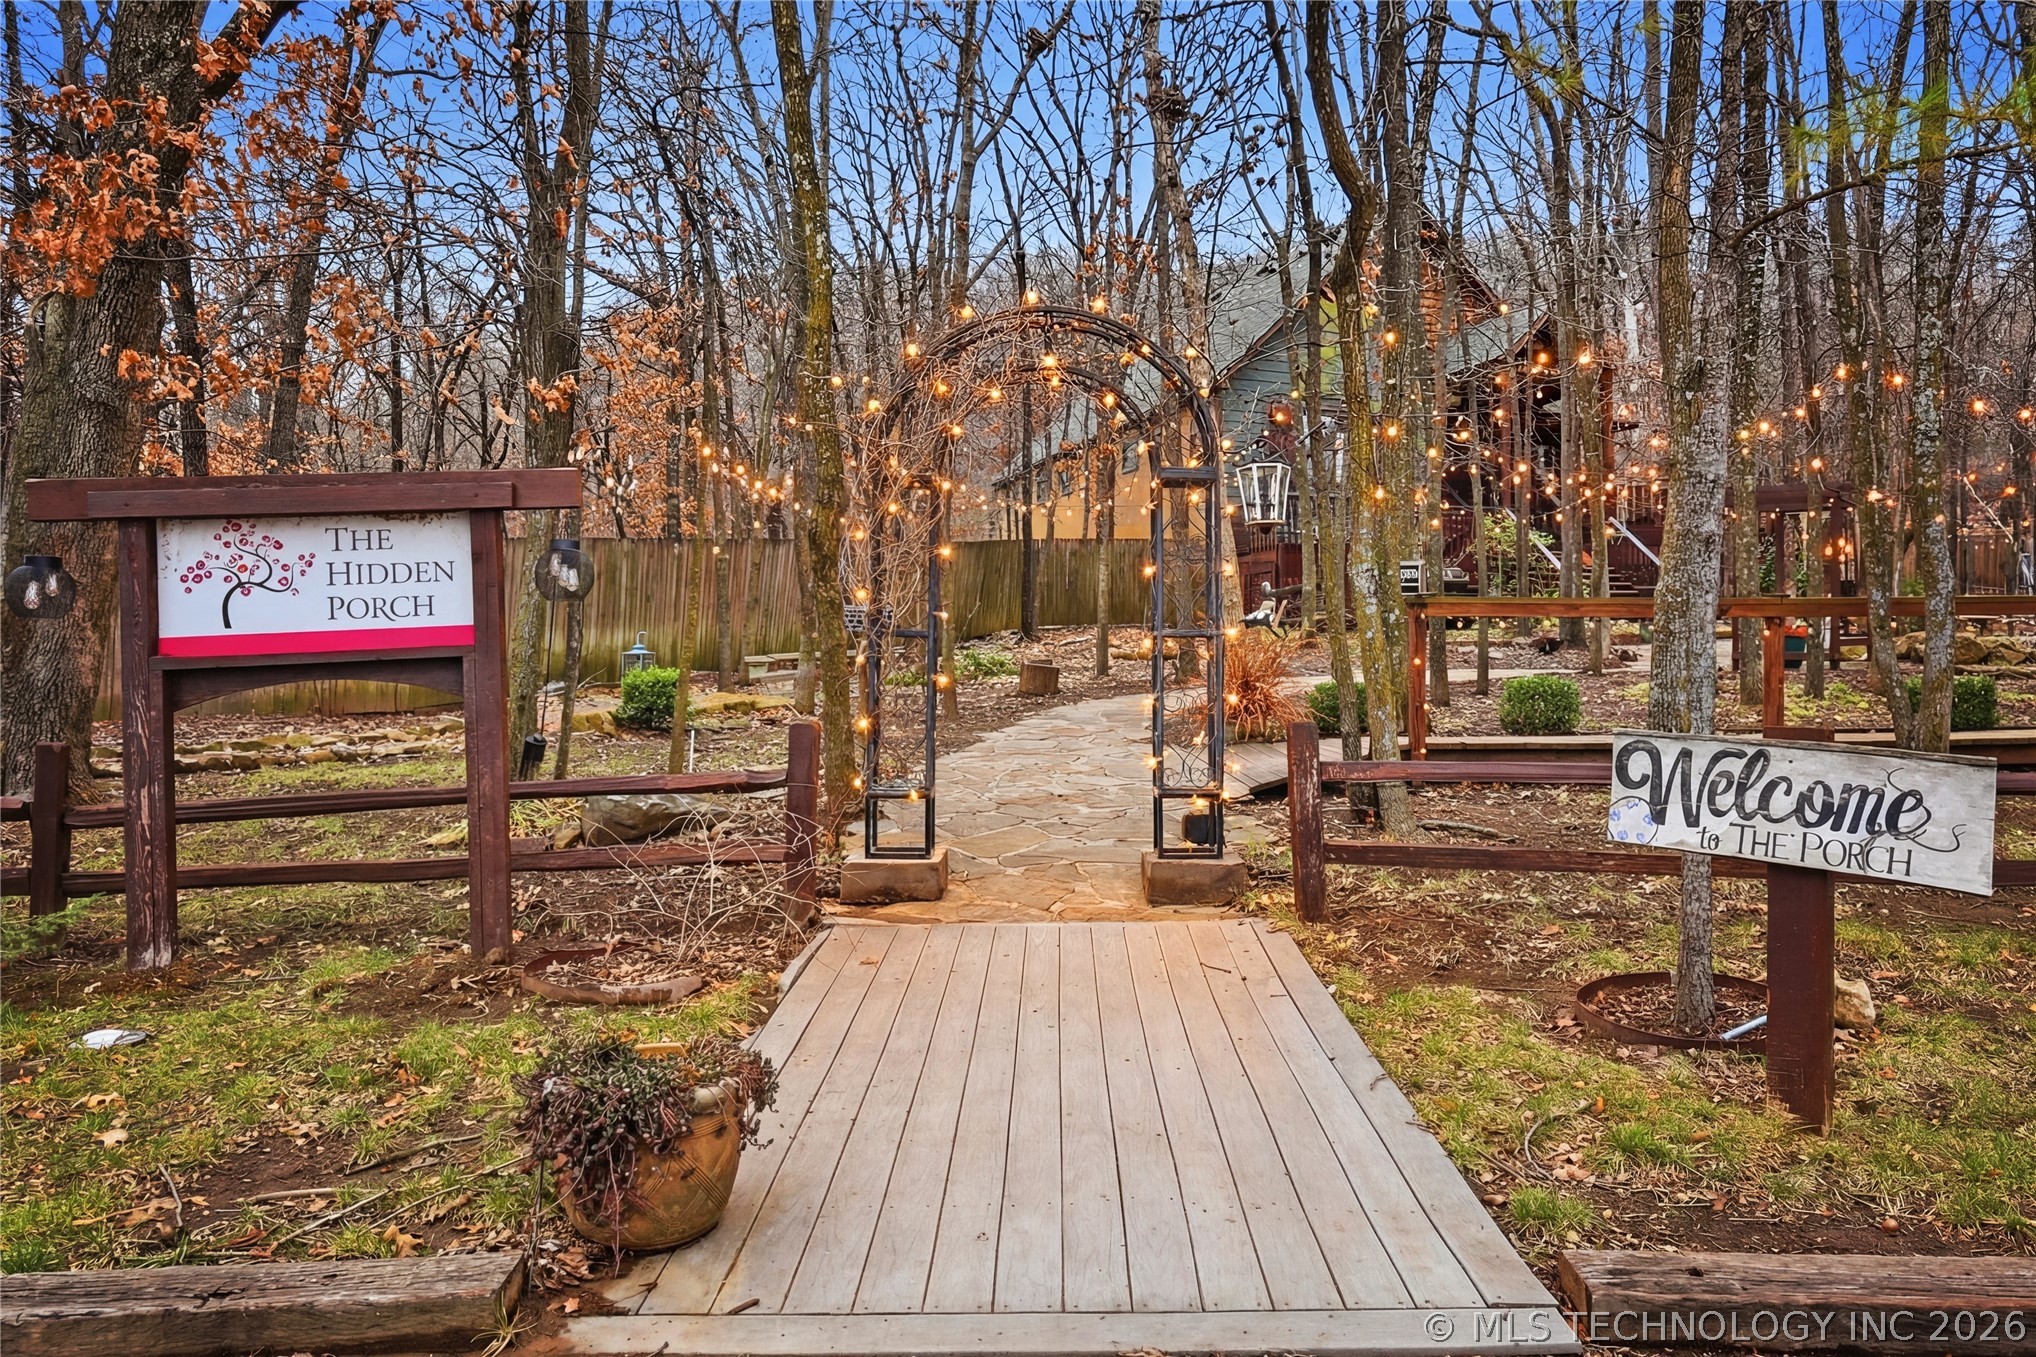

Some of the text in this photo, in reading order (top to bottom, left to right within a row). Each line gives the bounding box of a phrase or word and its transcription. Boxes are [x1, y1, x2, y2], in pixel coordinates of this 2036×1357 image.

[324, 526, 394, 552] THE
[325, 560, 456, 587] HIDDEN
[327, 594, 436, 622] PORCH
[1615, 739, 1933, 837] Welcome
[1696, 821, 1913, 876] to THE PORCH
